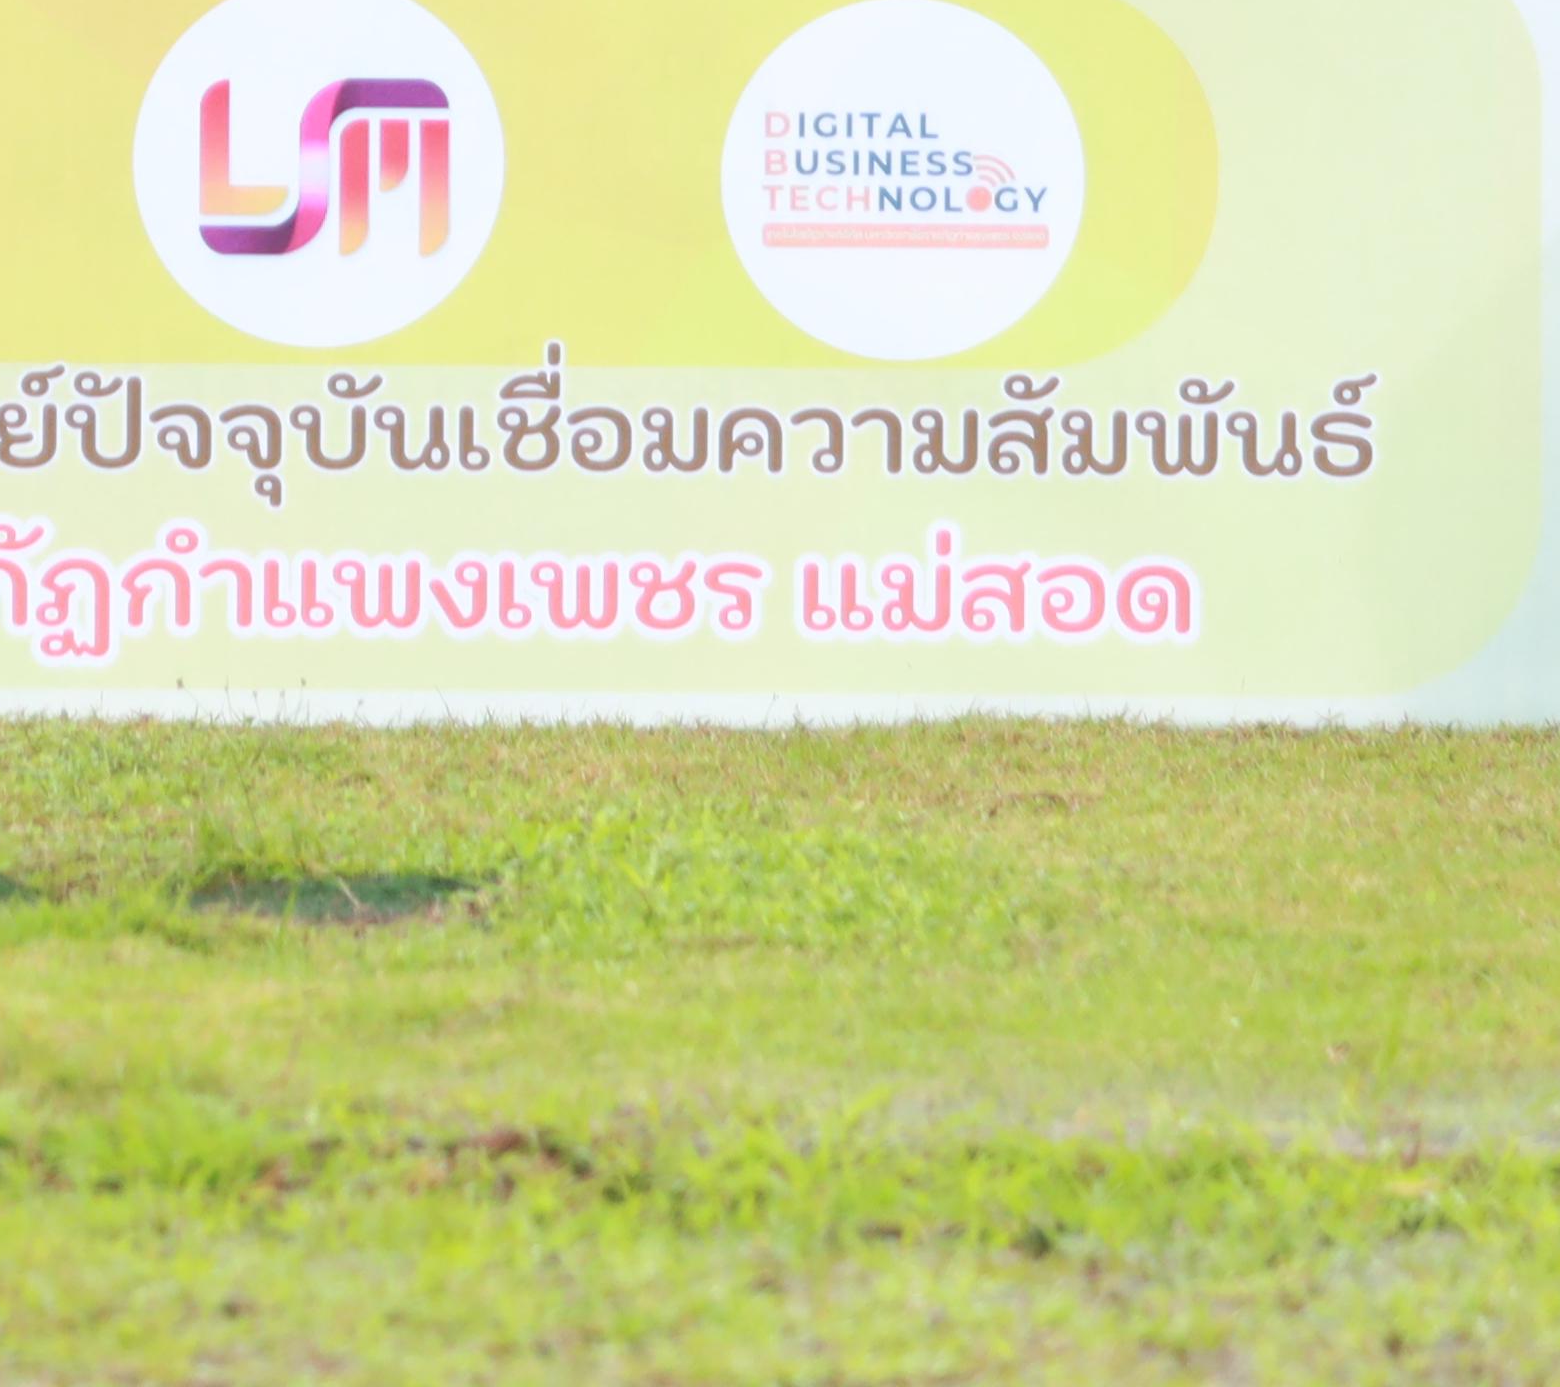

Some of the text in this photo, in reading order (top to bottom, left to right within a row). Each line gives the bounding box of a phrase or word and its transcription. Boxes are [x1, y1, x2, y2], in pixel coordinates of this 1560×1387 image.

[764, 112, 939, 139] DIGITAL
[764, 149, 975, 177] BUSINESS
[762, 184, 1049, 213] TECHNOLOGY
[802, 528, 1191, 634] แม่สอด
